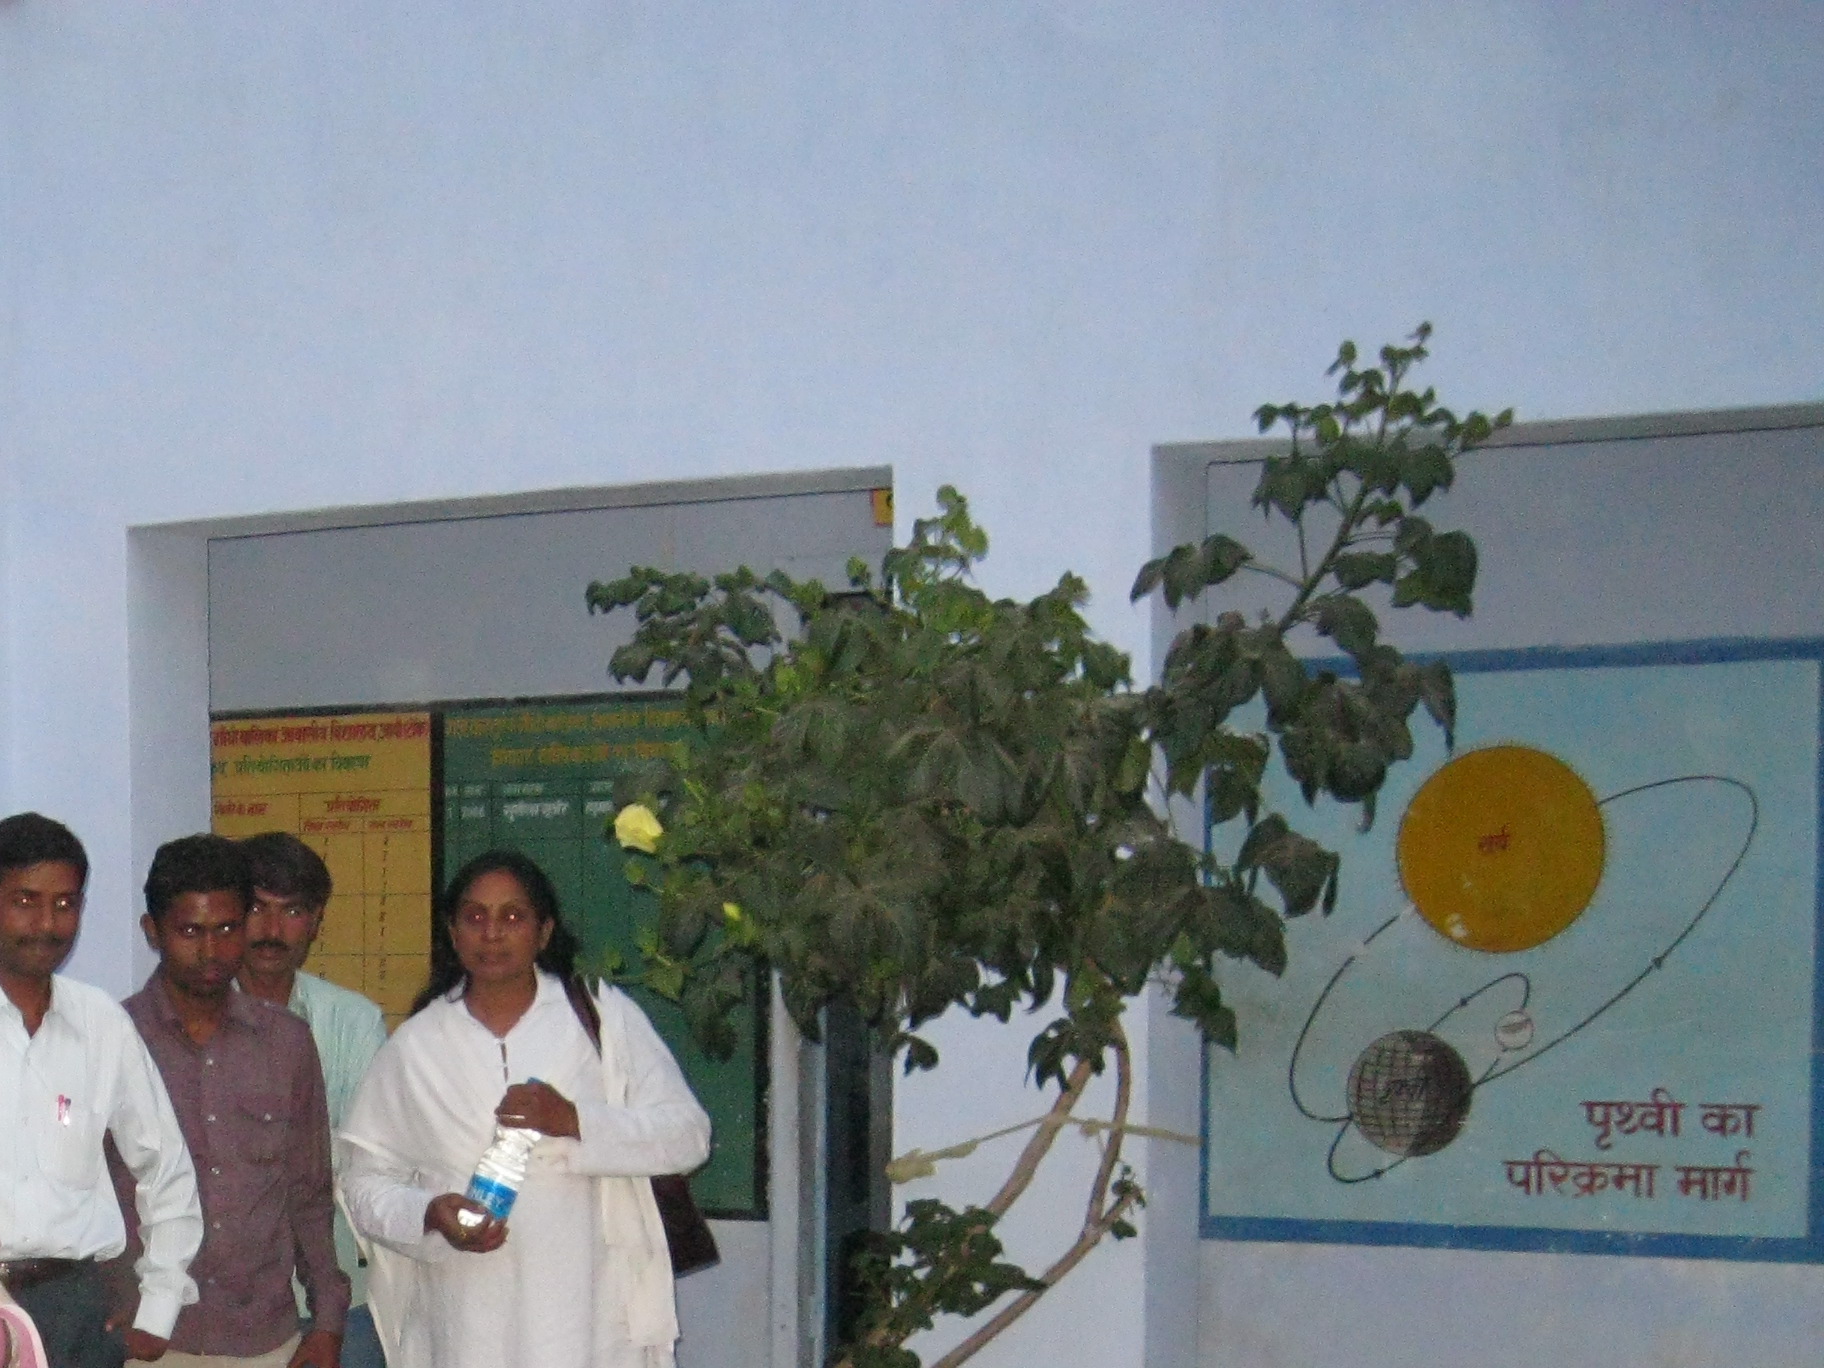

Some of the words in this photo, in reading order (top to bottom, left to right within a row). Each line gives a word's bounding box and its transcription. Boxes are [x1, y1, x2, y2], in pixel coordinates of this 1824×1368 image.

[1579, 1088, 1688, 1150] पृथ्वी
[1698, 1103, 1762, 1138] का
[1502, 1149, 1662, 1199] परिक्रमा
[1674, 1150, 1757, 1201] मार्ग
